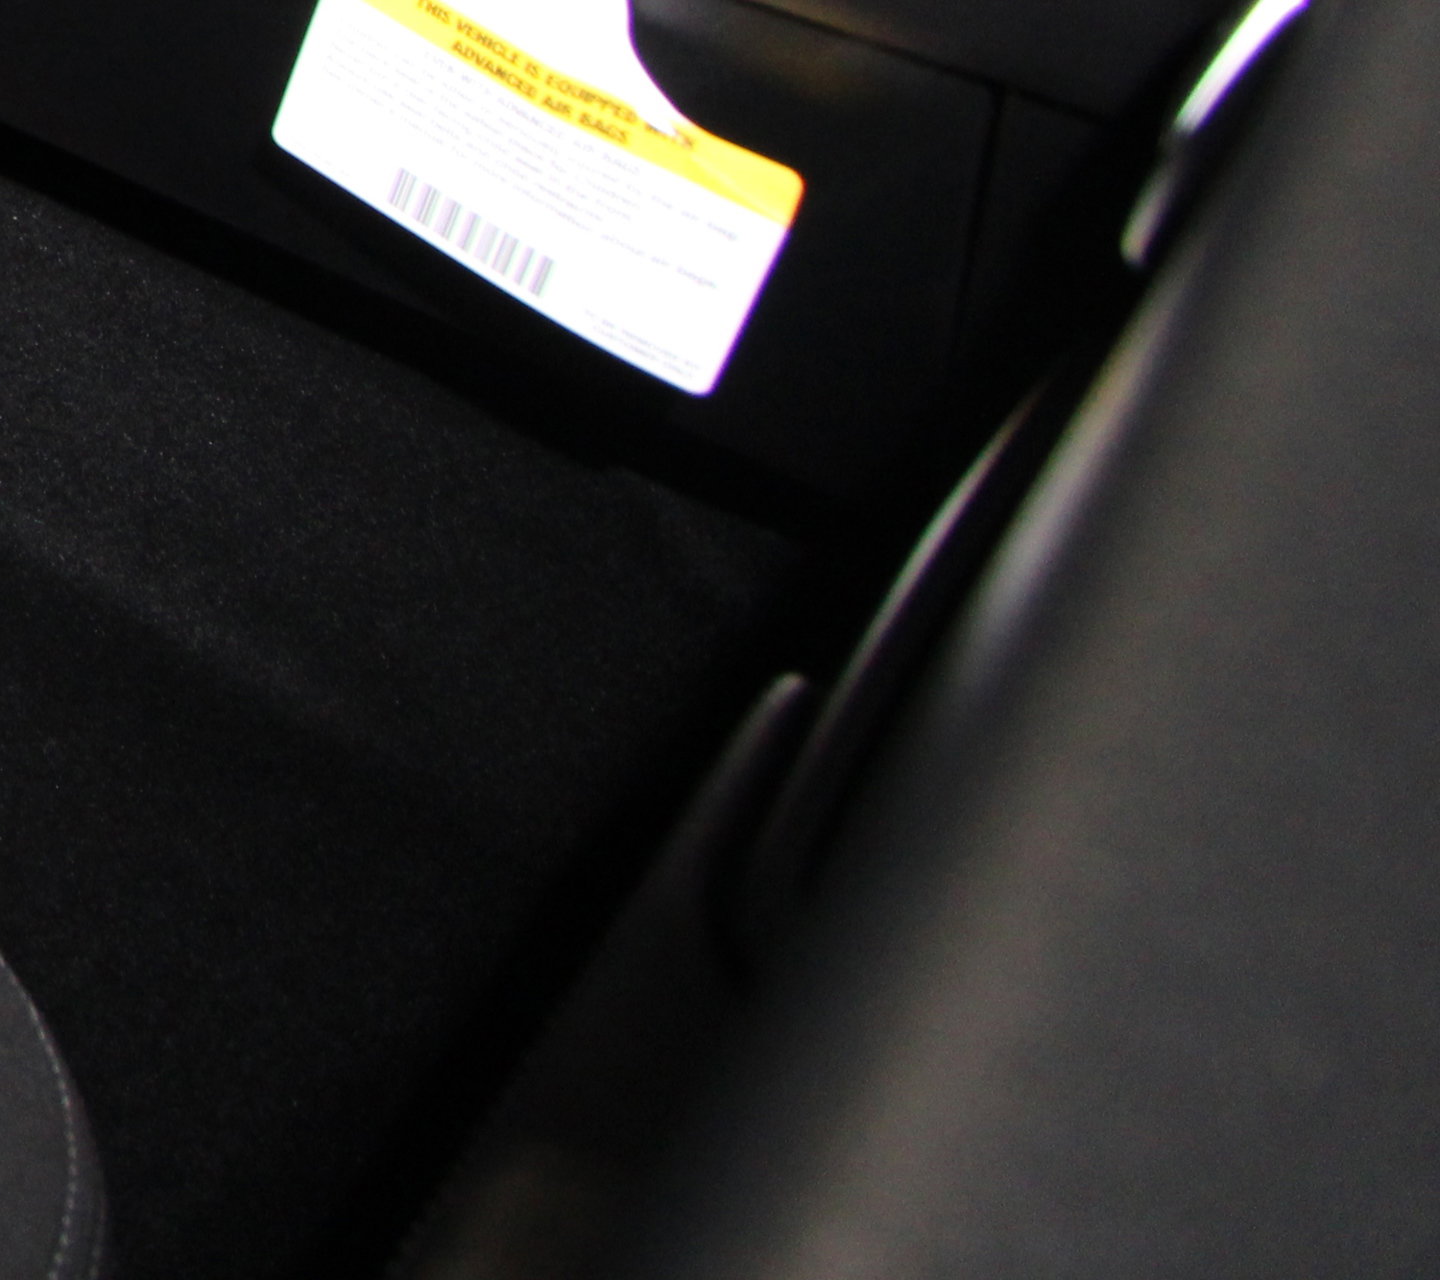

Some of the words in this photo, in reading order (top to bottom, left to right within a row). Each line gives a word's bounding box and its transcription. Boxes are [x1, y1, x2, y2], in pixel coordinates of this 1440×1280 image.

[452, 39, 539, 99] ADVANCED
[541, 93, 574, 119] AIR
[578, 111, 629, 143] BAGS
[455, 19, 523, 65] VEHICLE
[523, 61, 543, 80] IS
[544, 74, 638, 124] EQUIPPED
